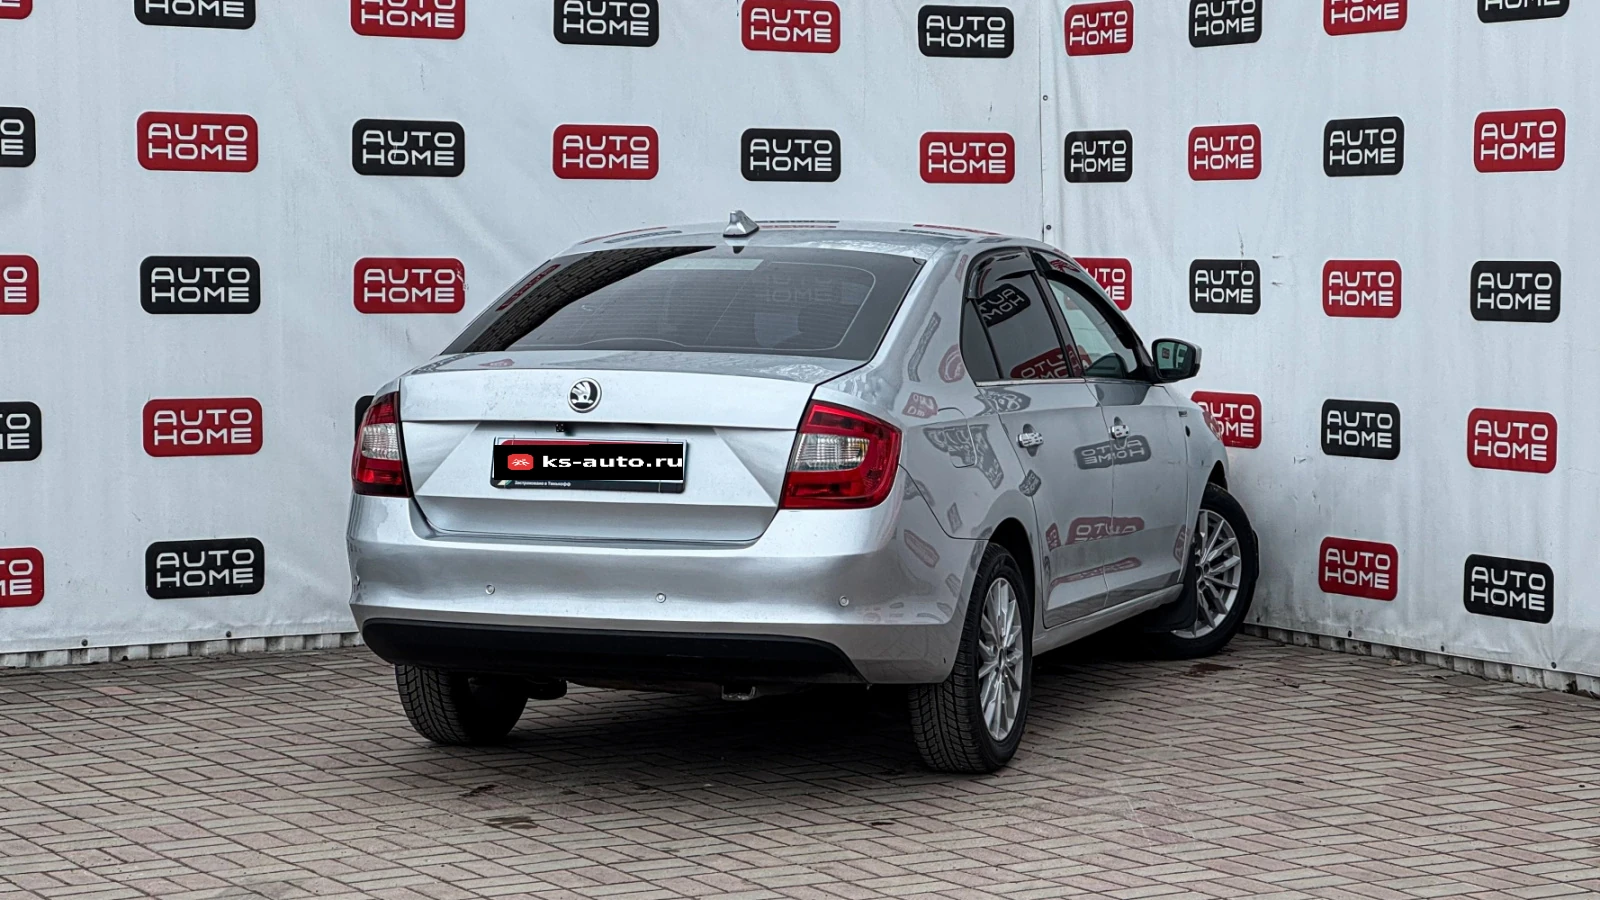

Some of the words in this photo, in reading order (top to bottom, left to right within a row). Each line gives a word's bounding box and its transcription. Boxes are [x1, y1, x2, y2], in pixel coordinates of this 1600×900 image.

[145, 0, 245, 18] HOME
[361, 8, 455, 29] HOME
[563, 0, 651, 18] AUTO
[750, 7, 833, 26] AUTO
[1194, 0, 1256, 19] AUTO
[1330, 2, 1400, 25] HOME
[563, 17, 649, 37] HOME
[926, 14, 1006, 32] AUTO
[1070, 10, 1128, 29] AUTO
[1194, 16, 1255, 37] HOME
[750, 25, 832, 43] HOME
[926, 31, 1005, 48] HOME
[1069, 27, 1127, 46] HOME
[147, 123, 248, 142] AUTO
[362, 129, 456, 149] AUTO
[1329, 128, 1397, 147] AUTO
[1480, 120, 1557, 141] AUTO
[148, 142, 247, 161] HOME
[562, 134, 650, 152] AUTO
[750, 138, 833, 155] AUTO
[928, 141, 1007, 157] AUTO
[1070, 140, 1127, 156] AUTO
[1193, 134, 1255, 152] AUTO
[1480, 141, 1556, 161] HOME
[362, 148, 455, 167] HOME
[562, 153, 649, 170] HOME
[749, 156, 832, 172] HOME
[928, 158, 1006, 174] HOME
[1070, 157, 1126, 173] HOME
[1193, 153, 1254, 170] HOME
[1329, 147, 1396, 166] HOME
[151, 267, 251, 284] AUTO
[364, 268, 456, 285] AUTO
[1194, 269, 1255, 286] AUTO
[1328, 270, 1395, 288] AUTO
[1477, 272, 1553, 290] AUTO
[151, 286, 250, 303] HOME
[363, 287, 455, 303] HOME
[1195, 287, 1254, 304] HOME
[1328, 289, 1394, 307] HOME
[1477, 292, 1551, 311] HOME
[153, 408, 253, 427] AUTO
[1326, 410, 1393, 430] AUTO
[154, 427, 252, 446] HOME
[1215, 420, 1255, 438] OME
[1326, 428, 1392, 449] HOME
[1474, 419, 1549, 441] AUTO
[1474, 439, 1547, 462] HOME
[156, 548, 255, 569] AUTO
[1325, 548, 1391, 571] AUTO
[156, 567, 254, 588] HOME
[1325, 566, 1389, 590] HOME
[1471, 566, 1546, 591] AUTO
[1470, 585, 1545, 612] HOME
